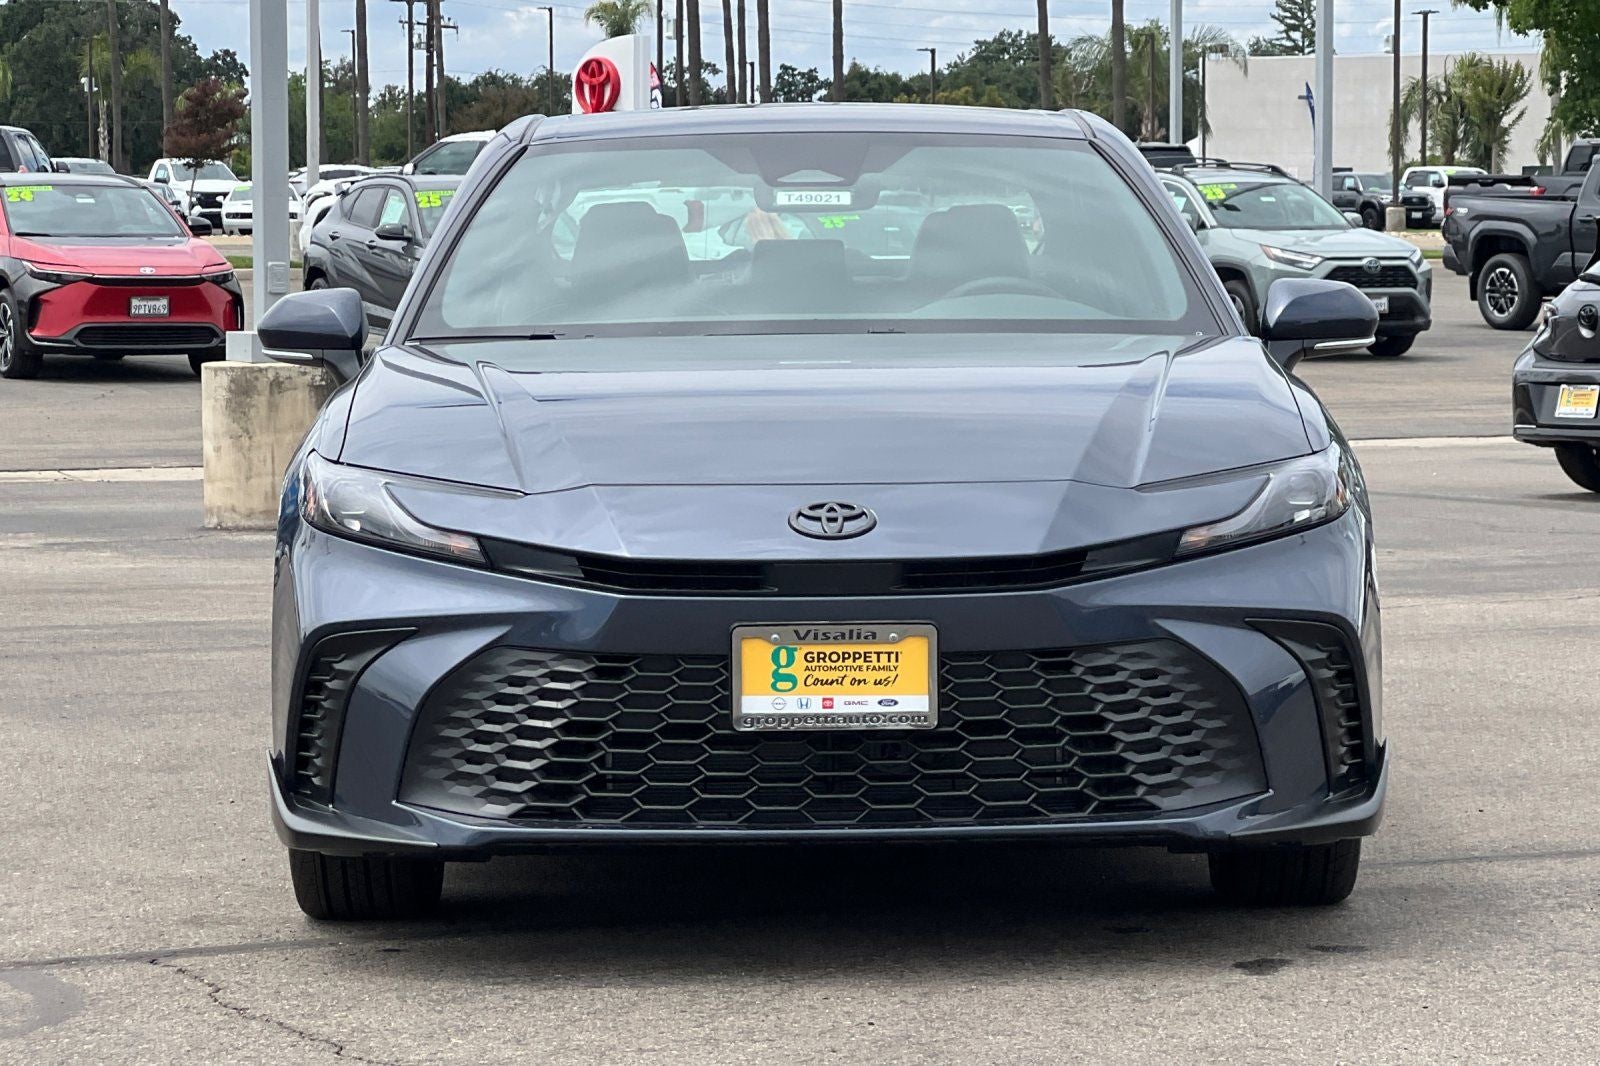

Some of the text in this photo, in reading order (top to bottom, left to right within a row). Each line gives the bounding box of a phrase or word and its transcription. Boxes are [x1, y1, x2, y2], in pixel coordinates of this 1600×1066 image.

[7, 190, 33, 202] 24
[418, 195, 442, 208] 25
[784, 193, 840, 203] T49021
[793, 628, 878, 641] Visalia
[803, 651, 900, 663] GROPPETTI
[803, 673, 899, 687] Count on us!
